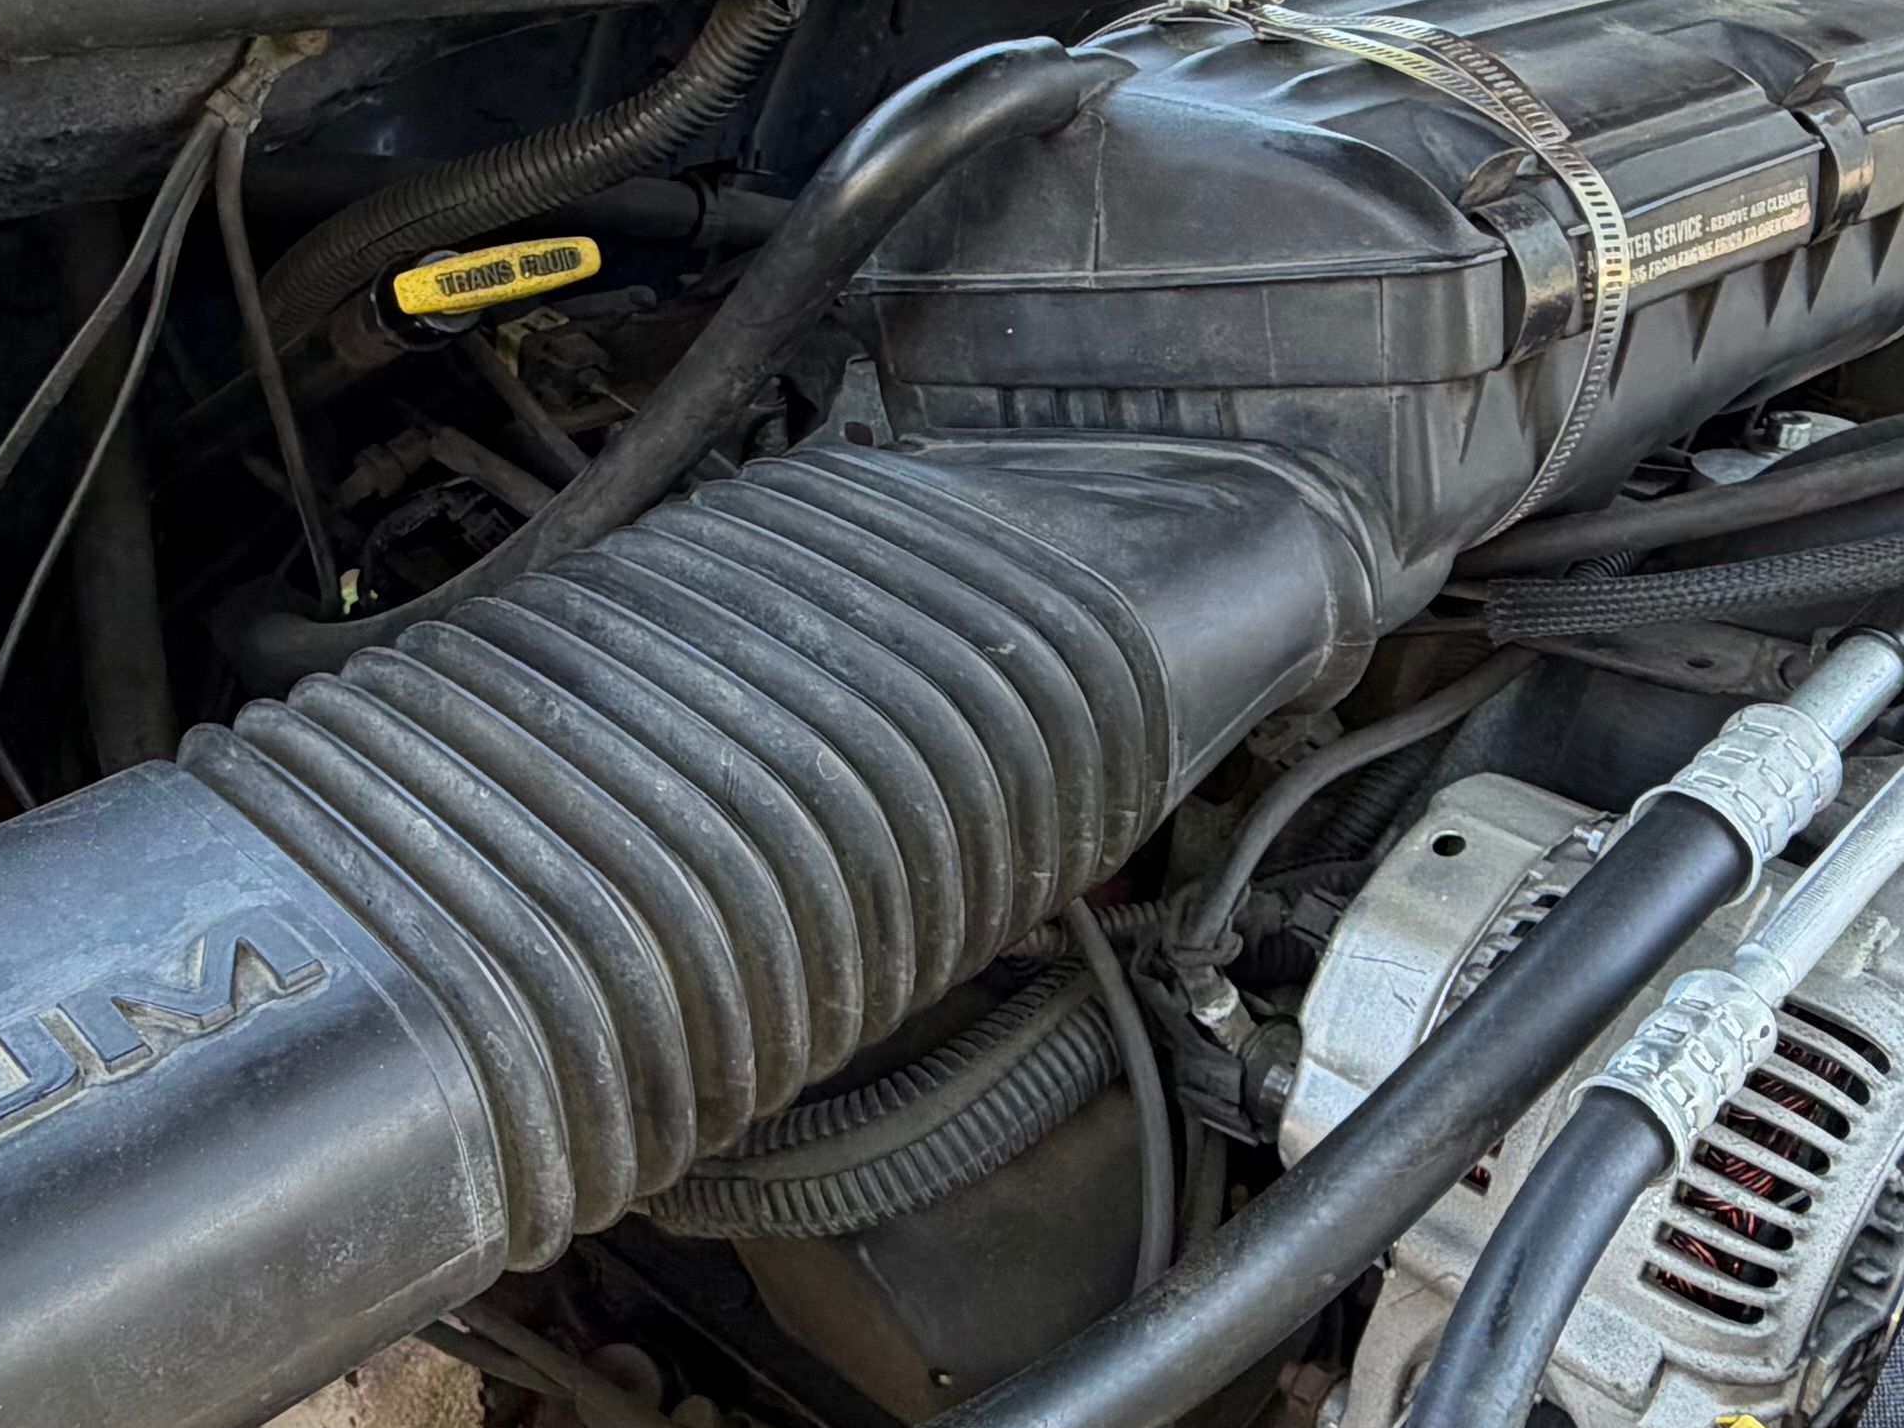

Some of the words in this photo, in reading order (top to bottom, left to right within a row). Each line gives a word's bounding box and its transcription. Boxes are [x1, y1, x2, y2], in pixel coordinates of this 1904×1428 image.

[1654, 214, 1704, 253] SERVICE
[437, 259, 516, 297] TRANS
[518, 246, 583, 282] FLUID
